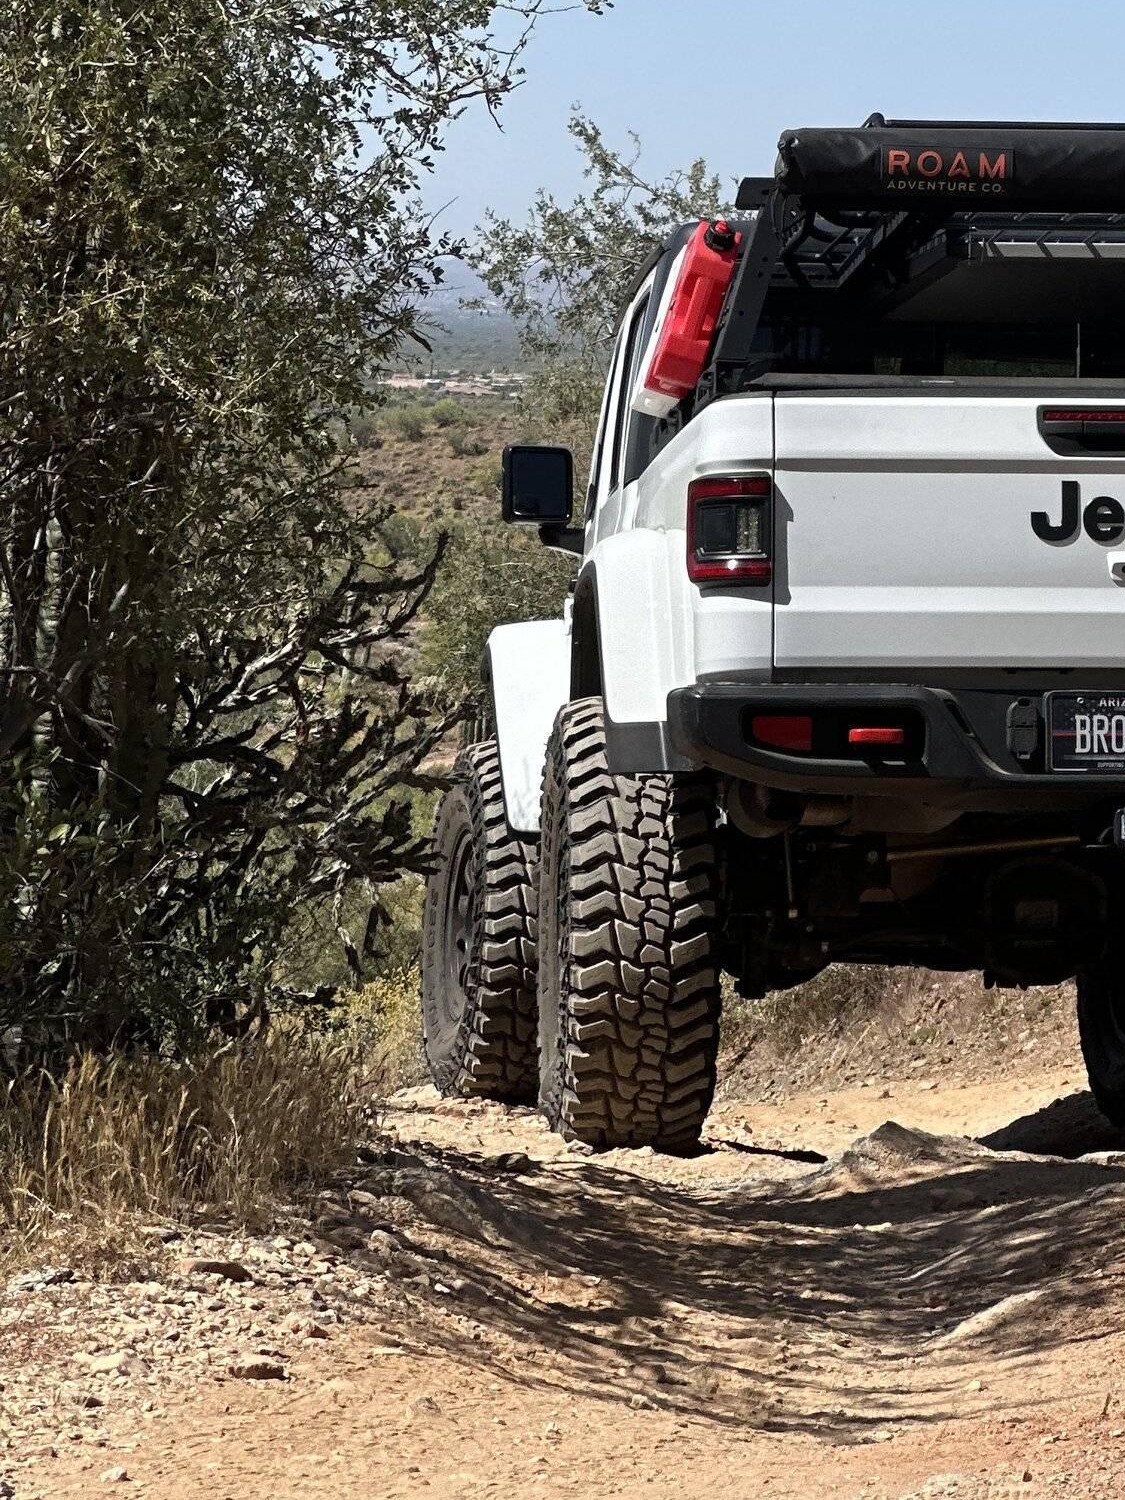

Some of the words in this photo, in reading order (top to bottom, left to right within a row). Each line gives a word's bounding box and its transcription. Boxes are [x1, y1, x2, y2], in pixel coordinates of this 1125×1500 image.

[888, 150, 1007, 179] ROAM
[887, 180, 977, 192] ADVENTURE
[981, 183, 1006, 193] CO.
